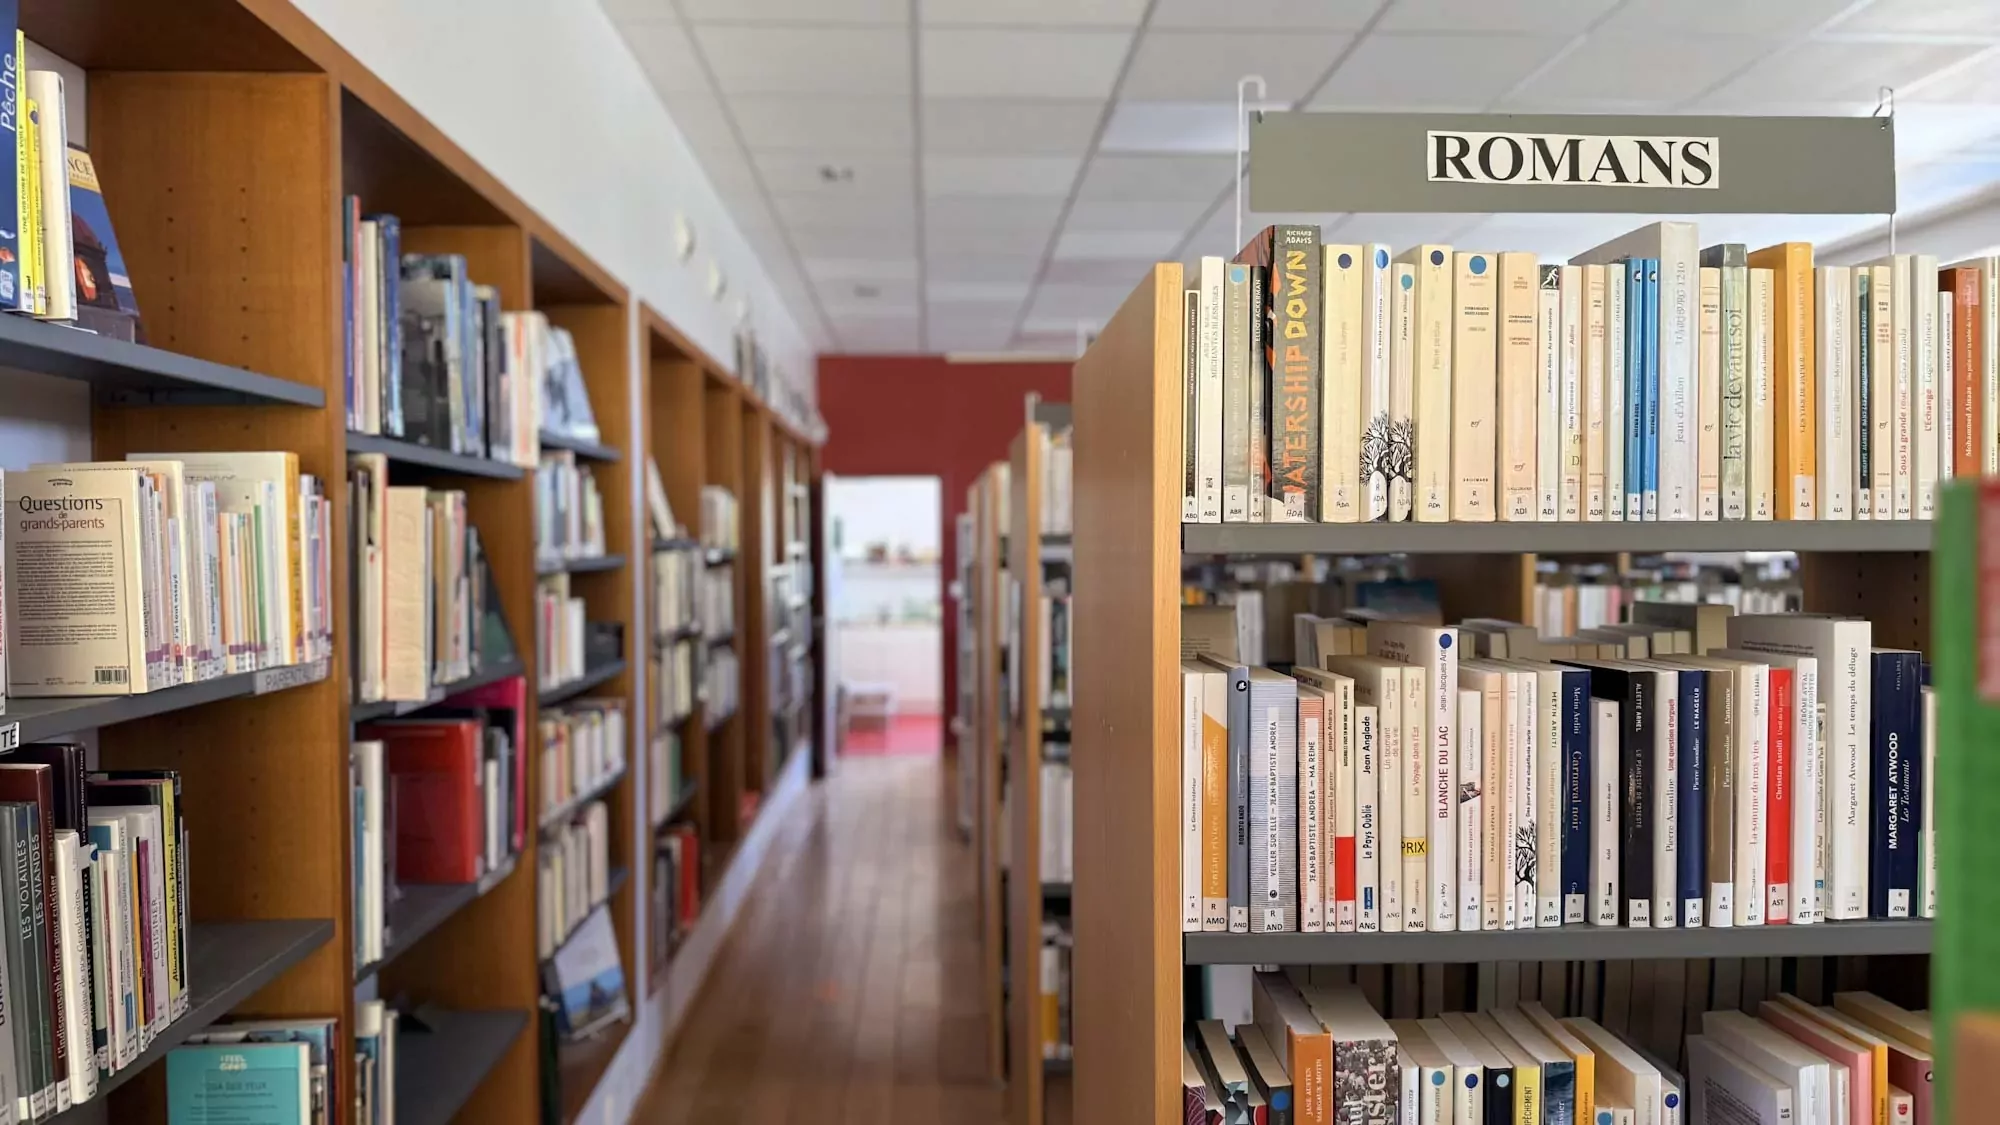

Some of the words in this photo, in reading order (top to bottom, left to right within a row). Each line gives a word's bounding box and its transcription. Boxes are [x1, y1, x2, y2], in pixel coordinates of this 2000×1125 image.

[0, 53, 16, 130] Pêche
[1432, 134, 1712, 186] ROMANS
[1285, 250, 1308, 339] DOWN
[1724, 308, 1742, 336] soi
[1674, 377, 1684, 418] d'Aillon
[1674, 422, 1686, 444] Jean
[1724, 413, 1742, 440] vie
[1899, 412, 1909, 442] grande
[1899, 445, 1907, 453] la
[1899, 456, 1907, 475] Sous
[19, 494, 103, 513] Questions
[58, 511, 68, 519] de
[20, 516, 104, 532] grands-parents
[1848, 648, 1857, 677] déluge
[1848, 680, 1856, 690] du
[1573, 687, 1581, 709] Metin
[1849, 694, 1857, 721] temps
[1573, 712, 1581, 734] Arditi
[1667, 699, 1675, 728] d'orgueil
[1362, 716, 1373, 752] Anglade
[1439, 726, 1448, 746] LAC
[1848, 724, 1856, 735] Le
[1667, 730, 1675, 757] question
[1362, 755, 1371, 774] Jean
[1439, 750, 1448, 764] DU
[1889, 733, 1897, 784] ATWOOD
[1308, 765, 1316, 777] MA
[1412, 762, 1421, 785] Voyage
[1572, 751, 1582, 802] Carnaval
[1901, 760, 1910, 805] Testaments
[1439, 768, 1448, 818] BLANCHE
[1750, 781, 1759, 793] de
[1665, 779, 1673, 822] Assouline
[1362, 805, 1371, 829] Oublié
[1572, 807, 1582, 830] noir
[1889, 787, 1897, 849] MARGARET
[1901, 808, 1910, 822] Les
[1362, 831, 1373, 848] Pays
[1665, 826, 1673, 852] Pierre
[32, 834, 43, 898] VIANDES
[1362, 851, 1371, 859] Le
[17, 840, 31, 911] VOLAILLES
[35, 903, 44, 926] LES
[21, 916, 32, 940] LES
